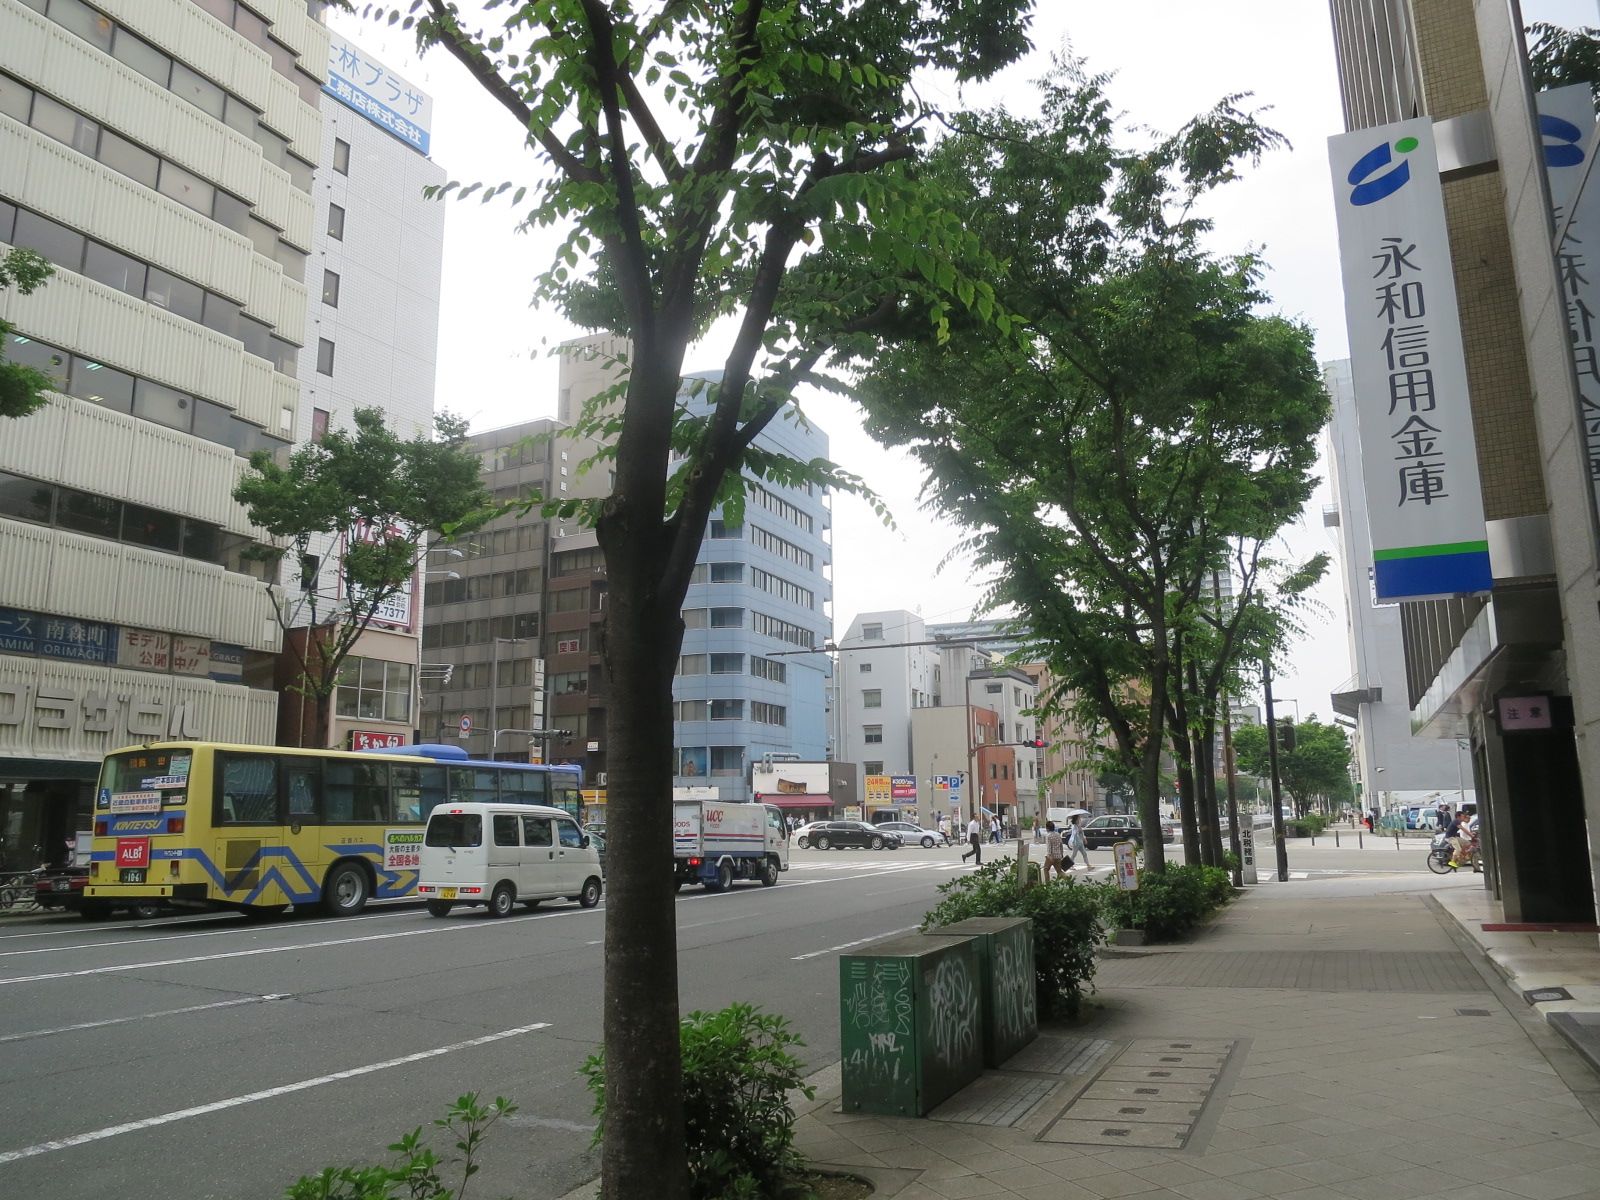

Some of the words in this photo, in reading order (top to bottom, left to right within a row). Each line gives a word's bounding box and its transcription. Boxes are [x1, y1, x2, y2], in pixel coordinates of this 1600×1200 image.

[329, 44, 424, 115] 林プラザ
[1373, 237, 1449, 507] 永和信用金庫
[706, 809, 724, 822] UCC
[113, 820, 162, 831] KINTETSU
[389, 845, 422, 853] 大阪の主要タ
